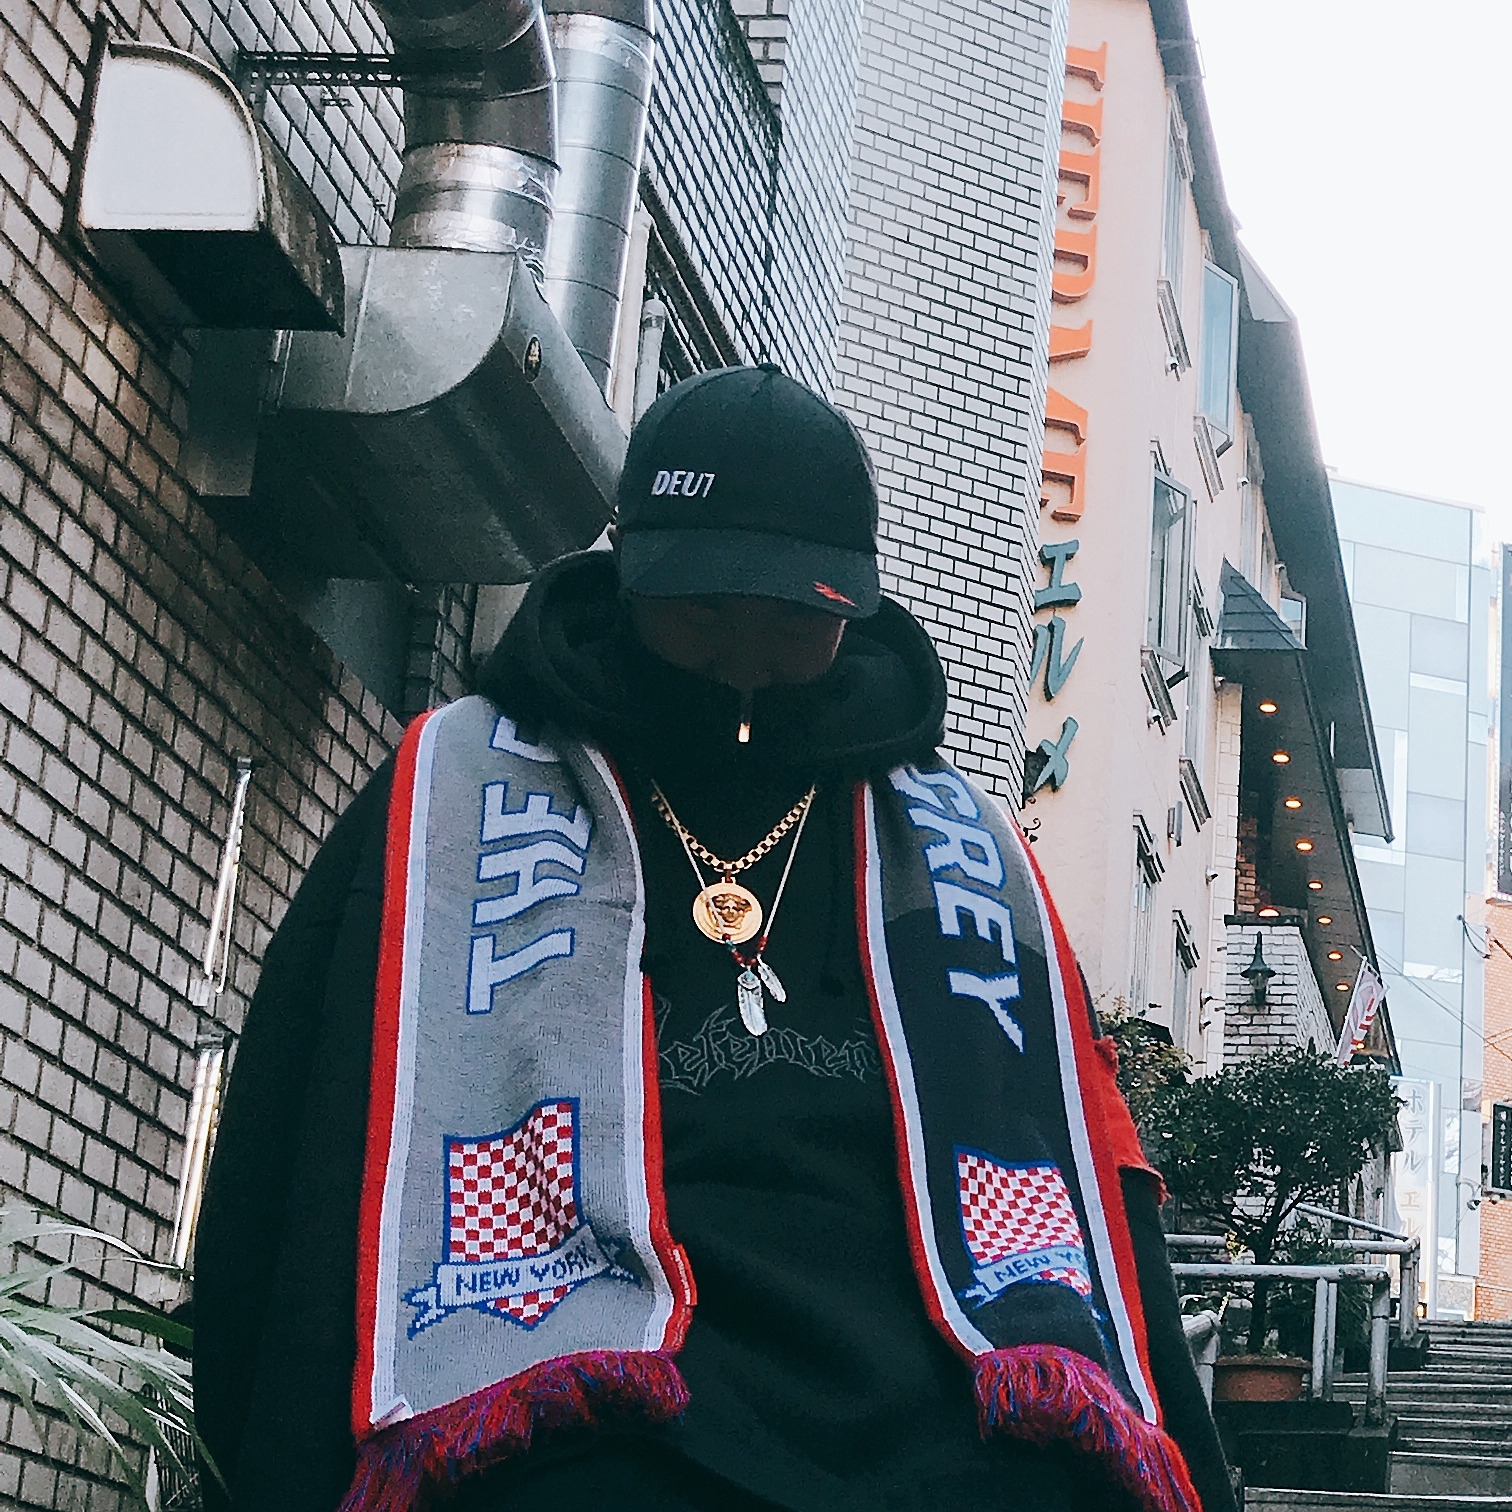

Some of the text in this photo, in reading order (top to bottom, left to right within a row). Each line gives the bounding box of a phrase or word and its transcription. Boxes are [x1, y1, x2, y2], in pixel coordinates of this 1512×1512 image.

[466, 780, 595, 1016] THE
[888, 764, 1026, 1055] GREY
[1402, 1088, 1425, 1174] ホテル
[455, 1240, 598, 1296] NEW YORK
[993, 1254, 1051, 1283] NEW
